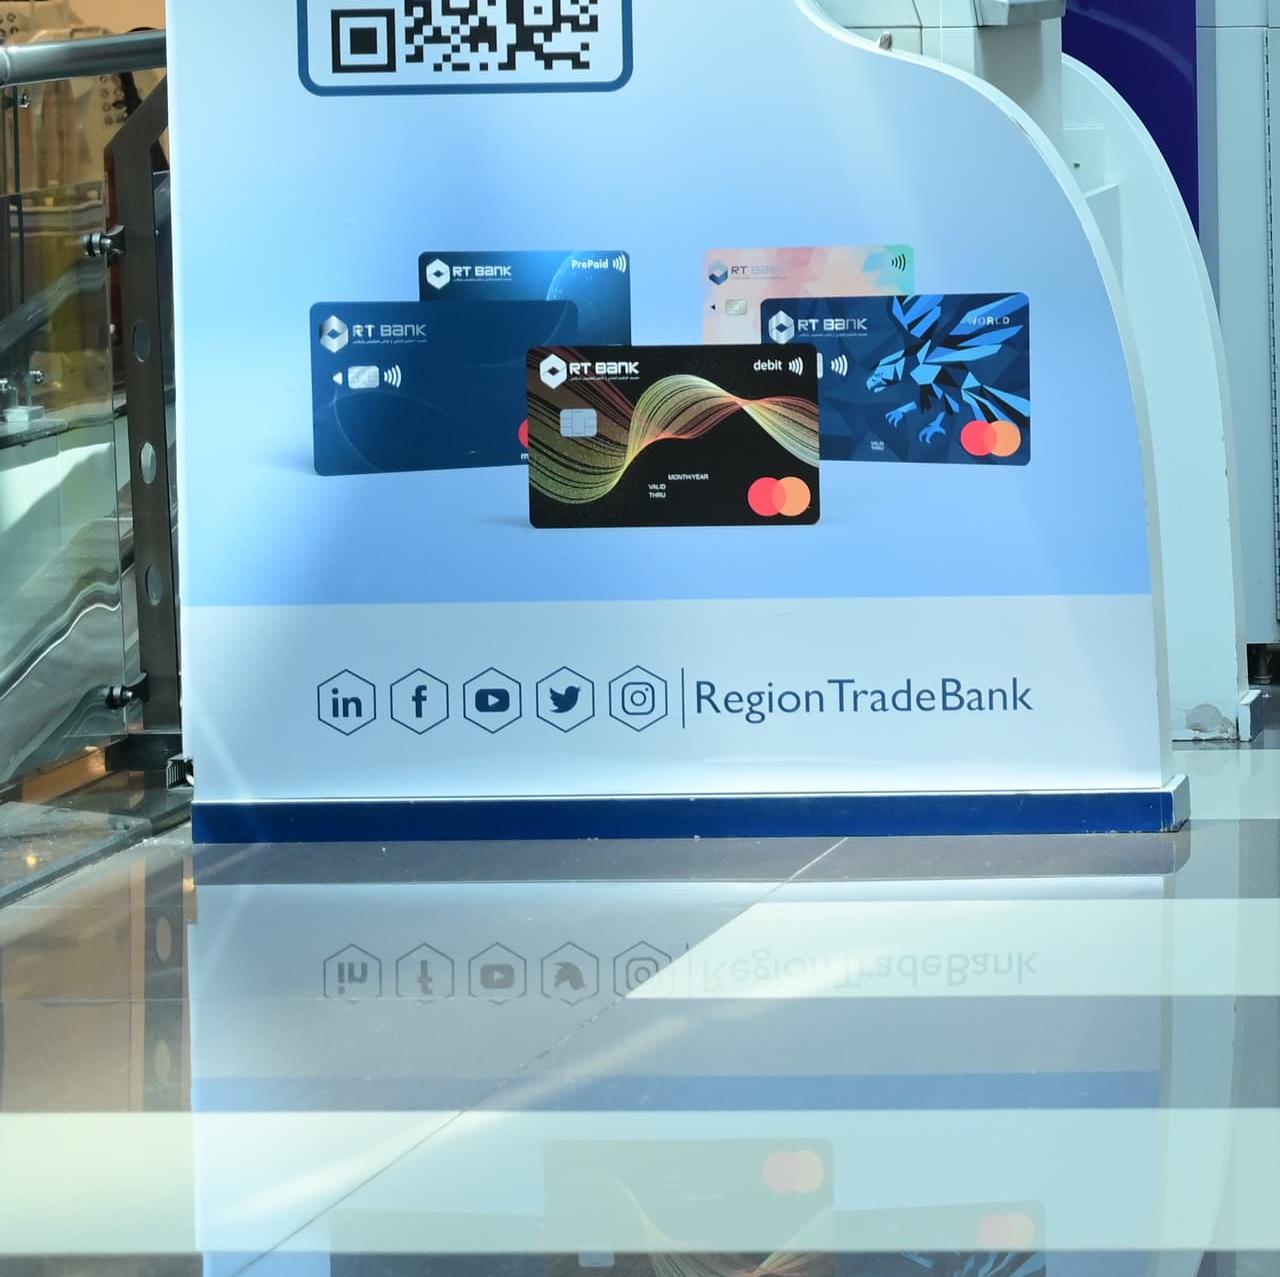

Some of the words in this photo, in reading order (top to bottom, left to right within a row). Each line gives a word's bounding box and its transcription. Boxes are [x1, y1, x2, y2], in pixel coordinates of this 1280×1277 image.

[452, 265, 471, 277] RT
[731, 265, 748, 275] RT
[798, 318, 819, 331] RT
[968, 316, 1011, 326] WORLD
[352, 324, 375, 338] RT
[569, 362, 591, 375] RT
[753, 359, 783, 372] debit
